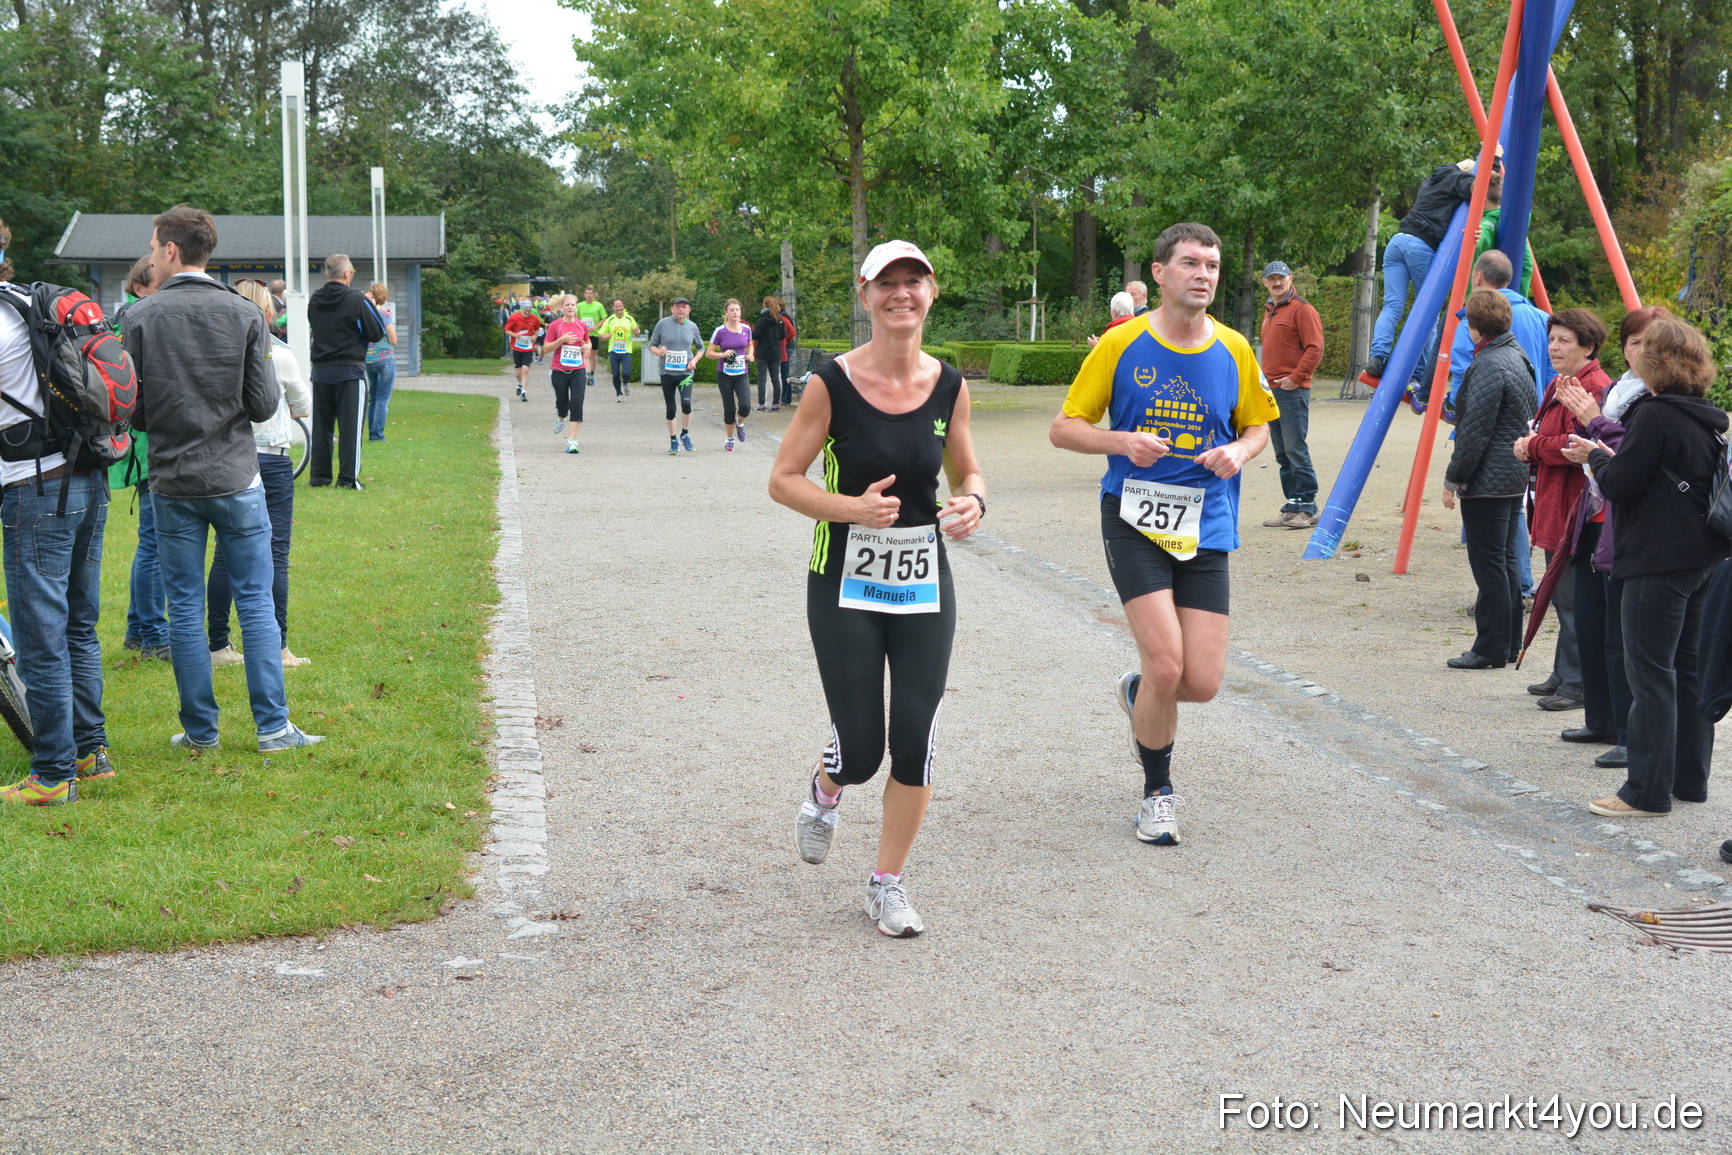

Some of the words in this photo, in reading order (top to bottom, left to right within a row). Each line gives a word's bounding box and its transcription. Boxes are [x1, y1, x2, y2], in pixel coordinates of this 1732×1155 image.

[667, 355, 686, 363] 2307
[1124, 486, 1152, 497] PARTL
[1153, 490, 1191, 502] Neumarkt
[1136, 500, 1187, 531] 257
[850, 532, 883, 544] PARTL
[885, 536, 925, 545] Neumarkt
[854, 547, 929, 581] 2155
[863, 585, 916, 602] Manuela
